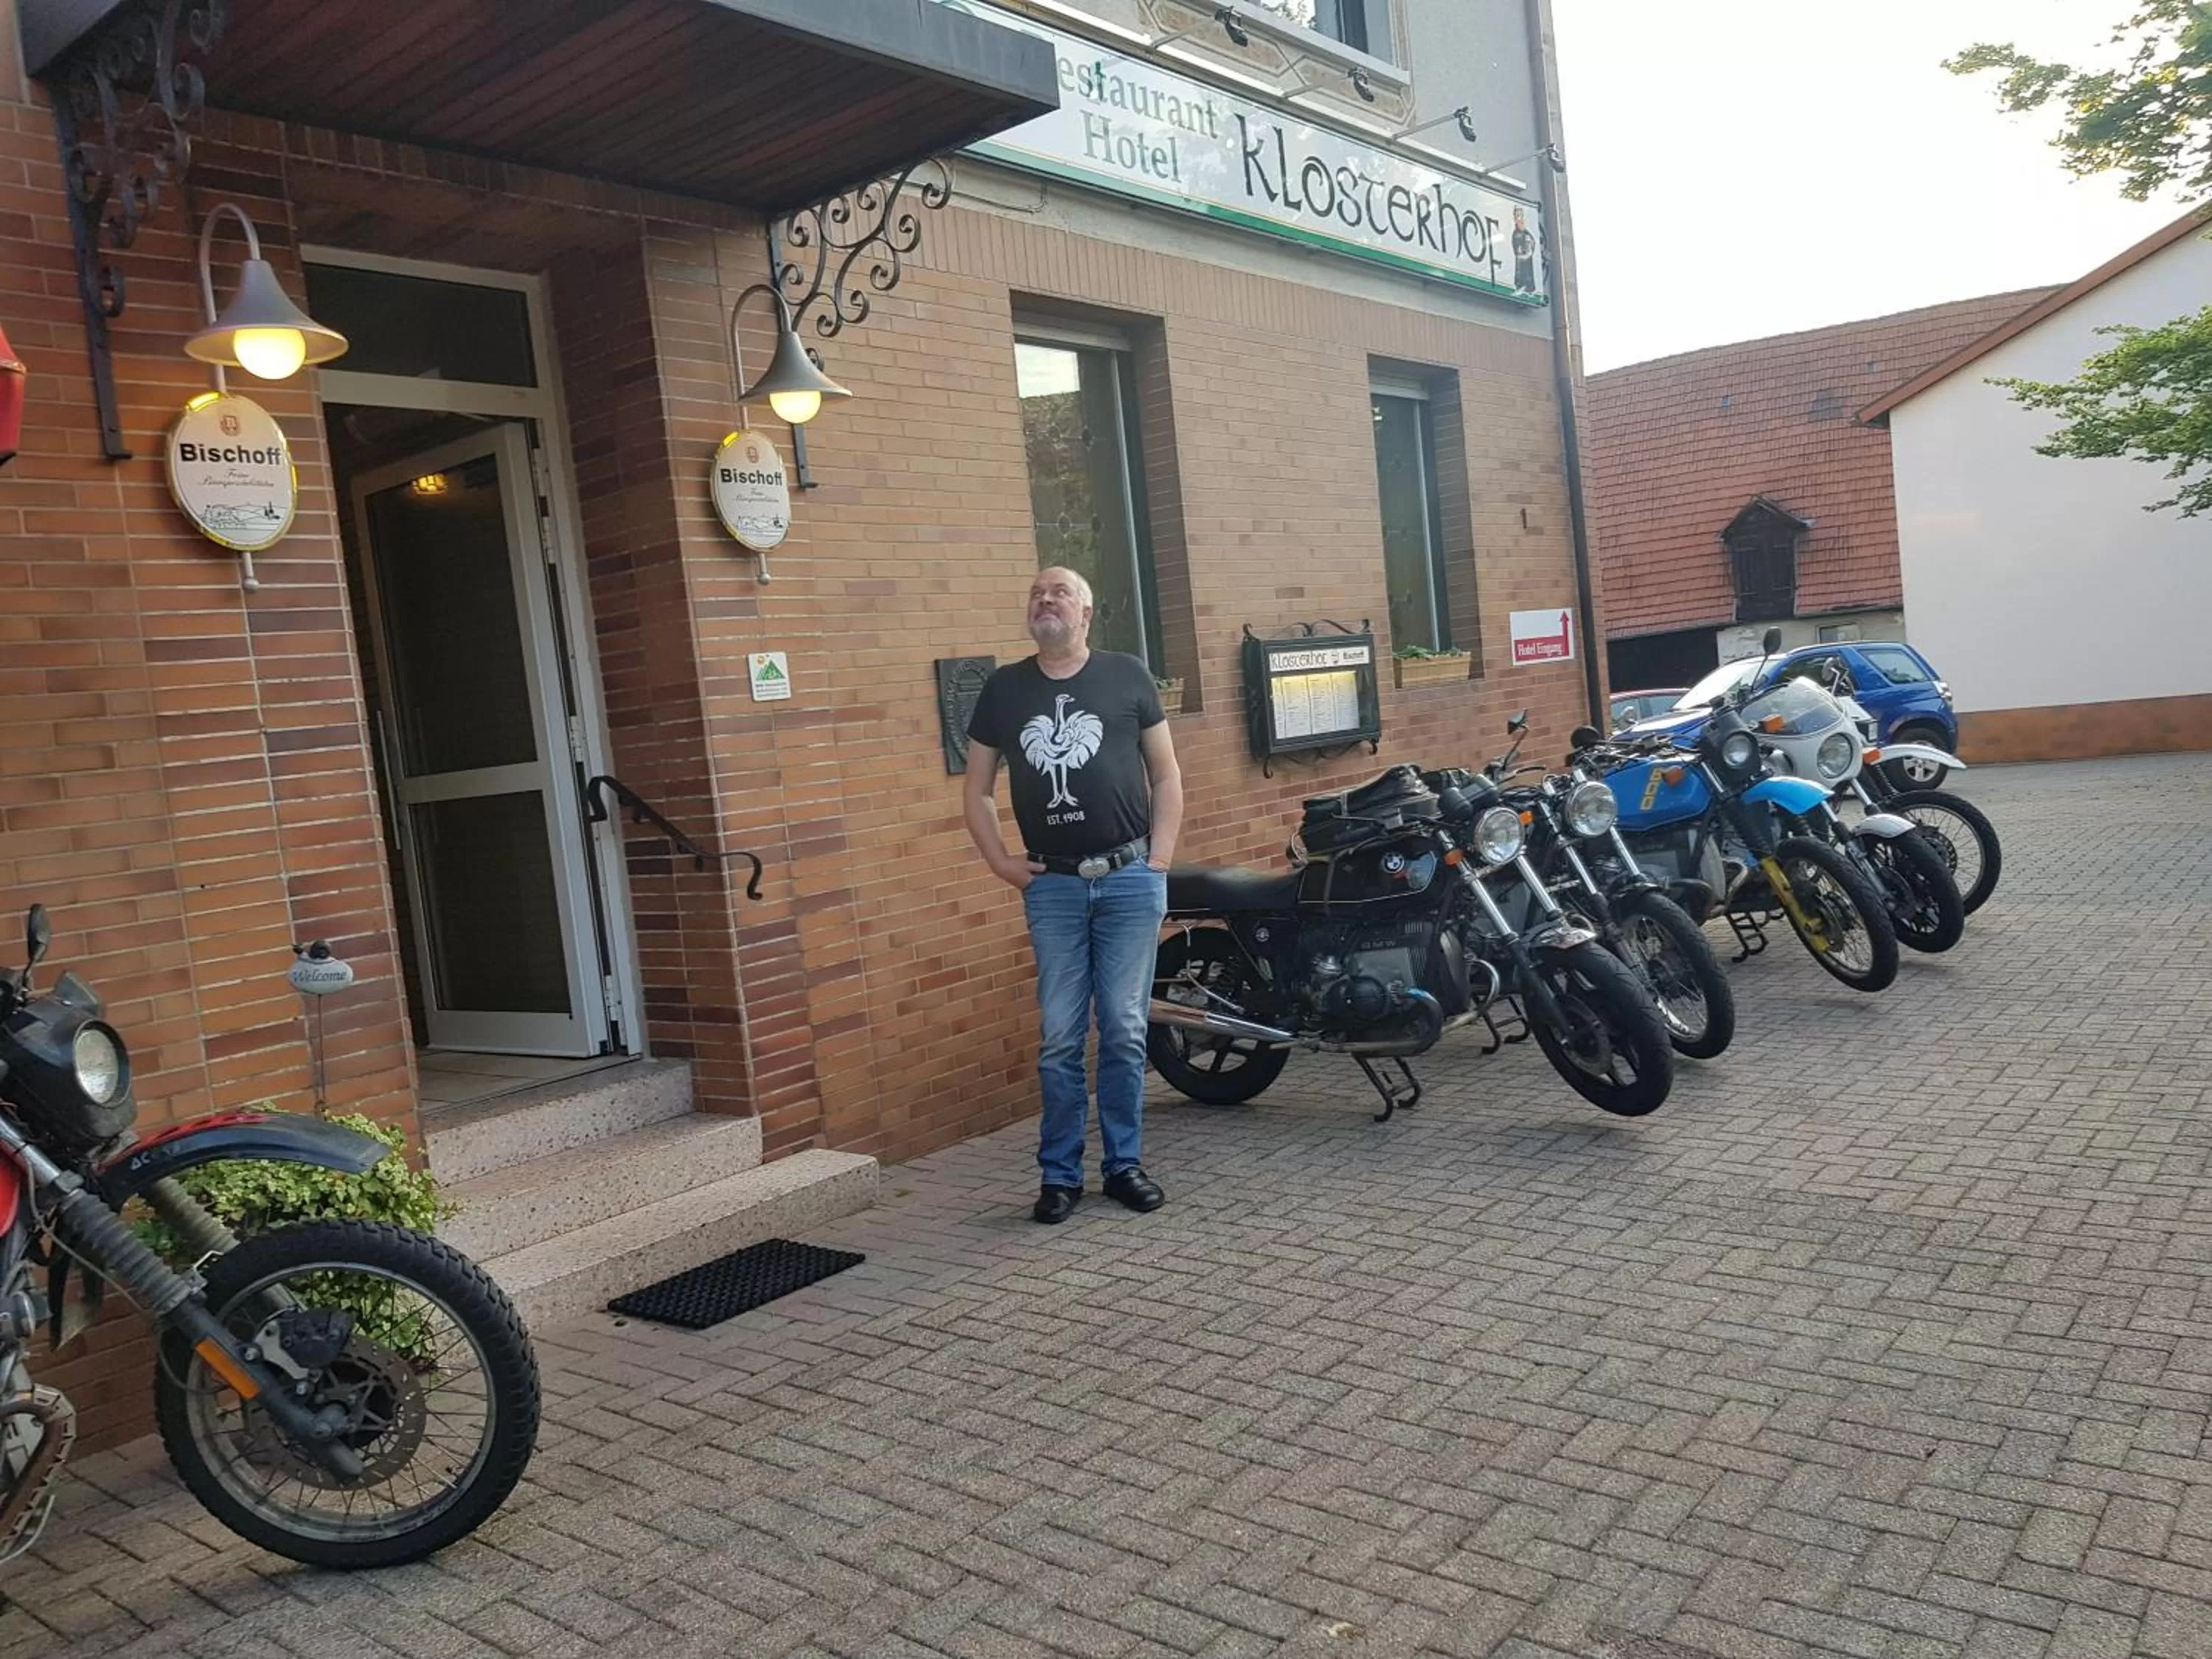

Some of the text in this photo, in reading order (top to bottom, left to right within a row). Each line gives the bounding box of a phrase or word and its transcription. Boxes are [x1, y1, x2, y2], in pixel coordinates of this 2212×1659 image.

[1057, 57, 1218, 139] estaurant
[1079, 109, 1181, 183] Hotel
[180, 442, 281, 465] Bischoff
[720, 468, 783, 486] Bischoff
[1517, 642, 1536, 656] Hotel
[1063, 810, 1085, 824] 1908
[292, 968, 348, 983] Welcome
